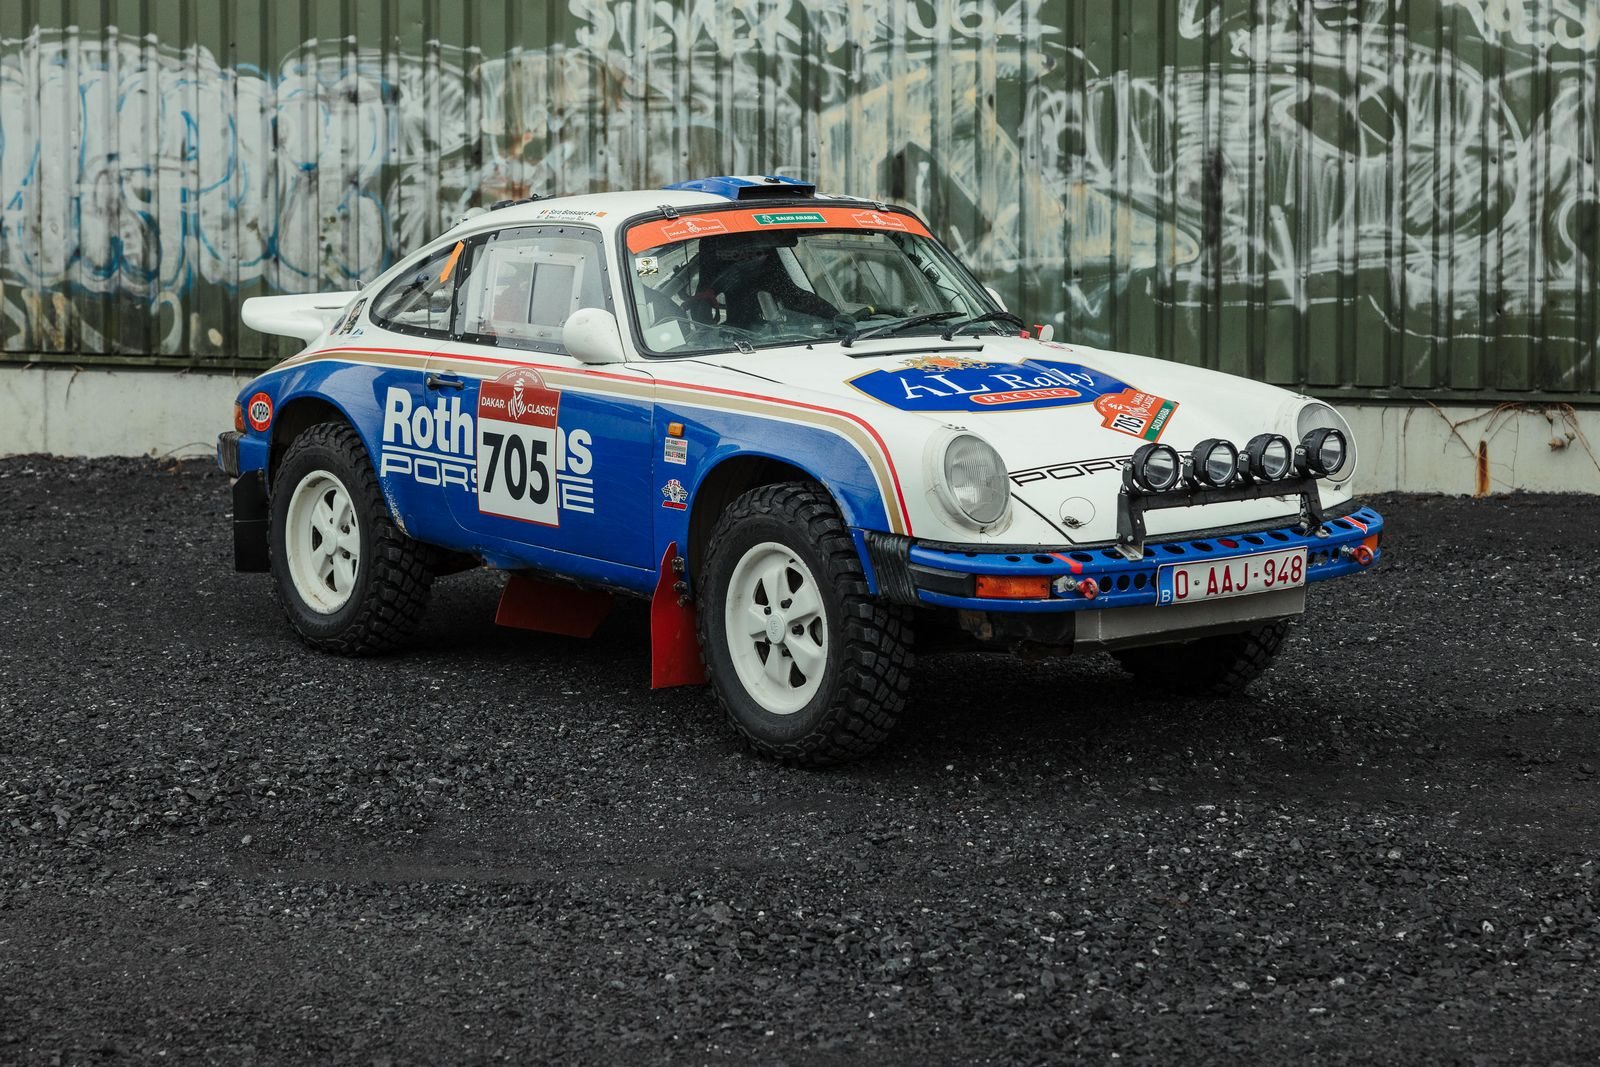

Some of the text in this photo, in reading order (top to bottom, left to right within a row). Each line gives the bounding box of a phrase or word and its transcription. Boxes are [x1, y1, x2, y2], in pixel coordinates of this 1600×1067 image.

[899, 368, 1096, 400] AL Rally
[982, 388, 1071, 403] RACING
[1141, 395, 1157, 409] CLASSIC
[481, 396, 557, 417] DAKAR CLASSIC
[1113, 414, 1144, 434] 705
[482, 431, 550, 505] 705
[1161, 590, 1171, 603] B
